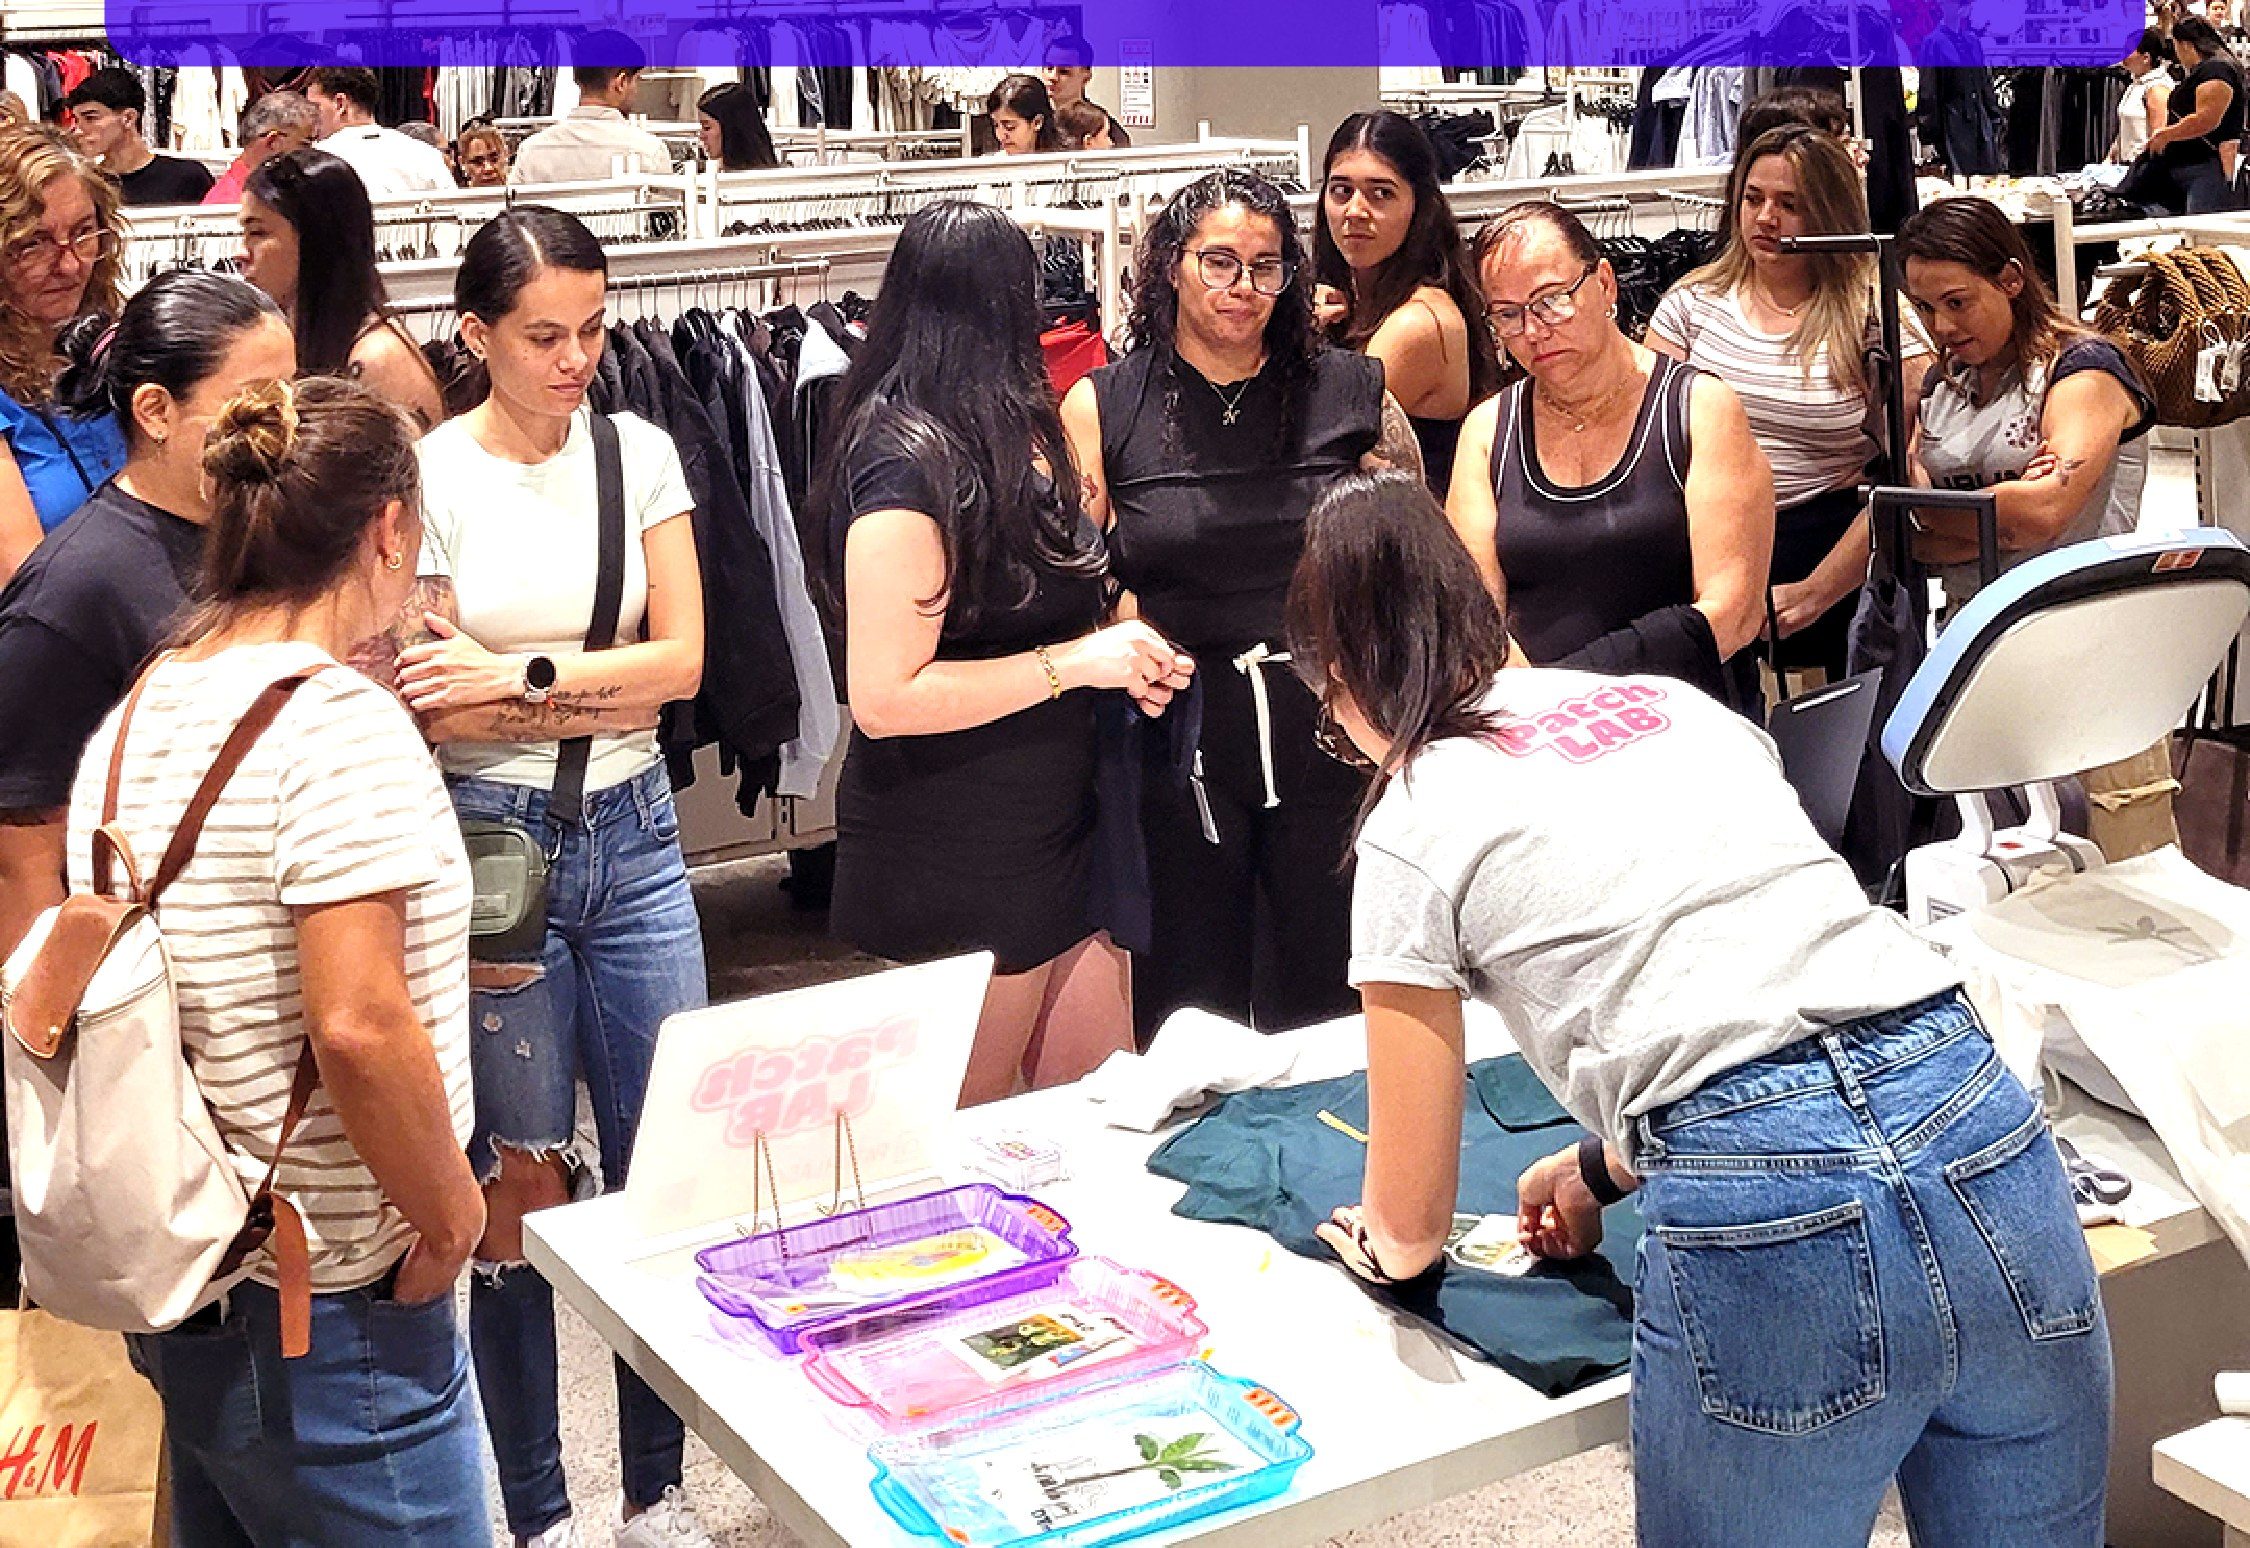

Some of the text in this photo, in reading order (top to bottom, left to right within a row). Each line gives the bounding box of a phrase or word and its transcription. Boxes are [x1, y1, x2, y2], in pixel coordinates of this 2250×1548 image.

[1497, 685, 1659, 750] Patch
[1554, 707, 1663, 758] LAB
[0, 1420, 98, 1500] H&M
